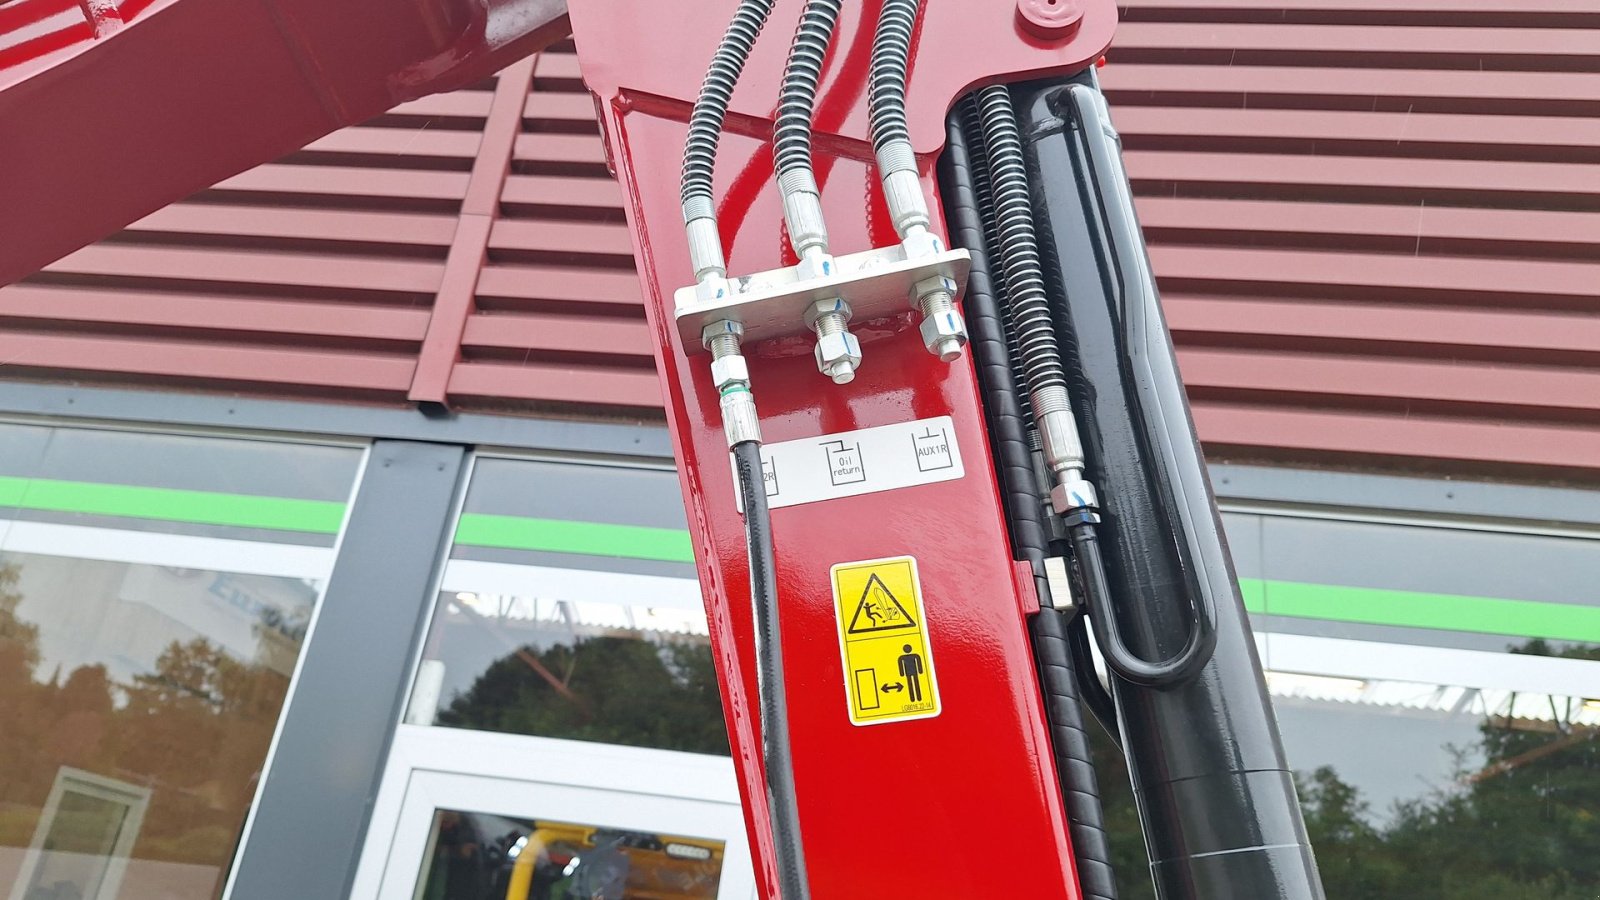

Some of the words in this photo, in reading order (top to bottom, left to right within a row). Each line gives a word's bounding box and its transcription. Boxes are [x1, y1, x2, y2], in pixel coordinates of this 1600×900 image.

[918, 444, 948, 458] AUX1R
[838, 457, 853, 467] Oil
[833, 466, 861, 477] return
